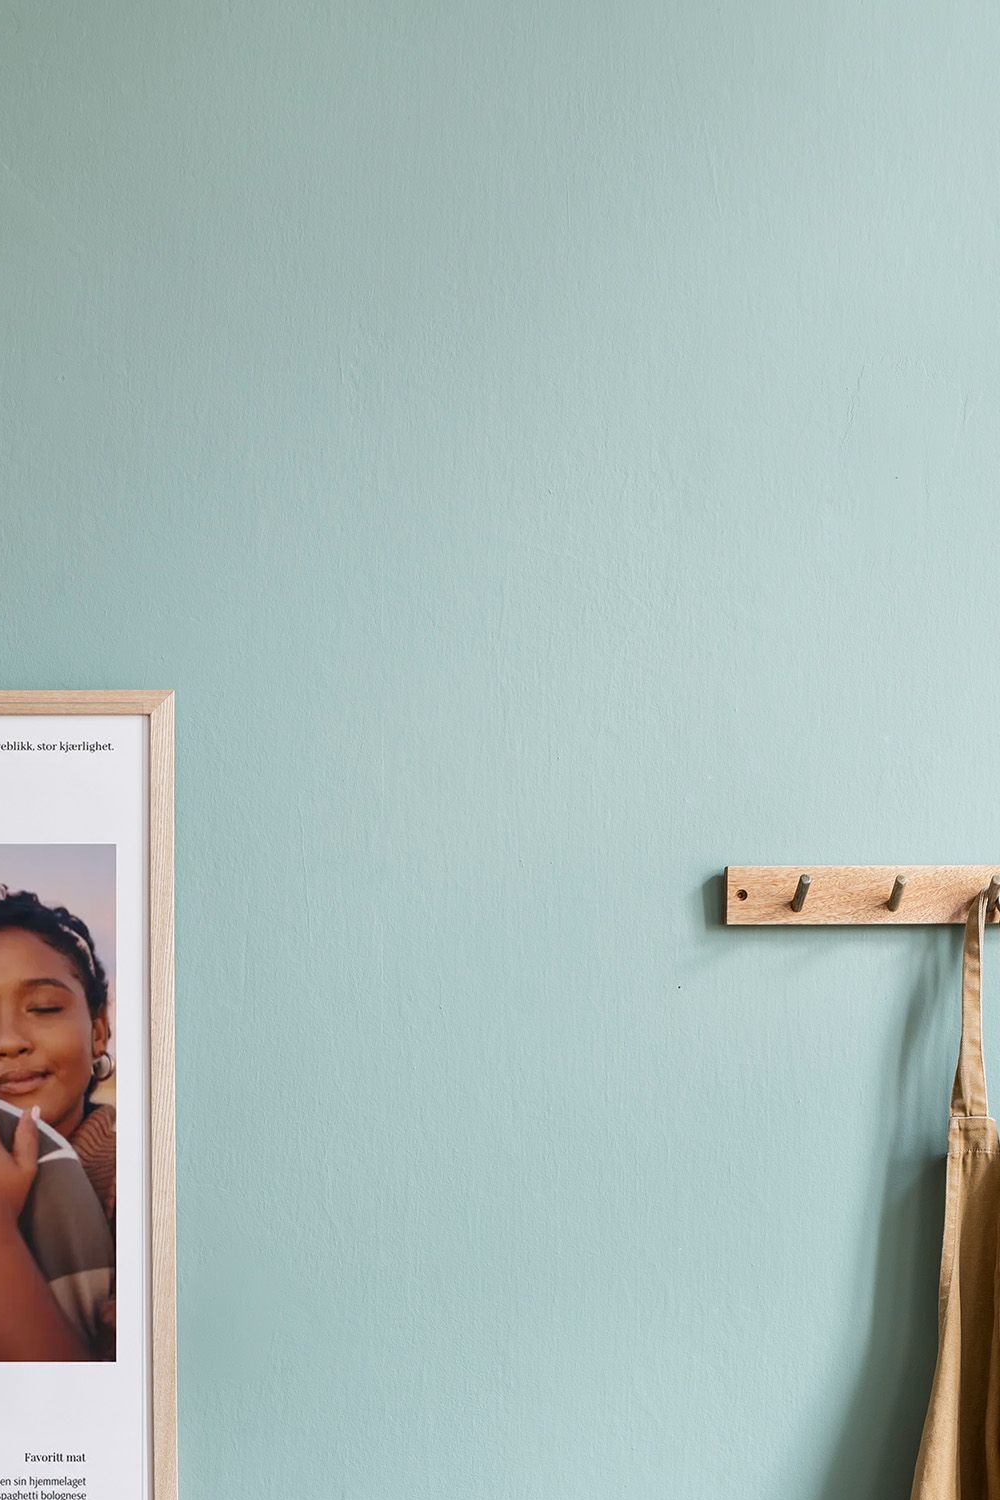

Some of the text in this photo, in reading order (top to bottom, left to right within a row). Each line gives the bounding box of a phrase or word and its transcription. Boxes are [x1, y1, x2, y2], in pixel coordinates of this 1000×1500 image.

[37, 742, 57, 752] stor
[59, 741, 115, 753] kjærlighet.
[24, 1452, 86, 1462] Favoritt mat
[13, 1476, 27, 1486] sin
[29, 1476, 87, 1488] hjemmelaget
